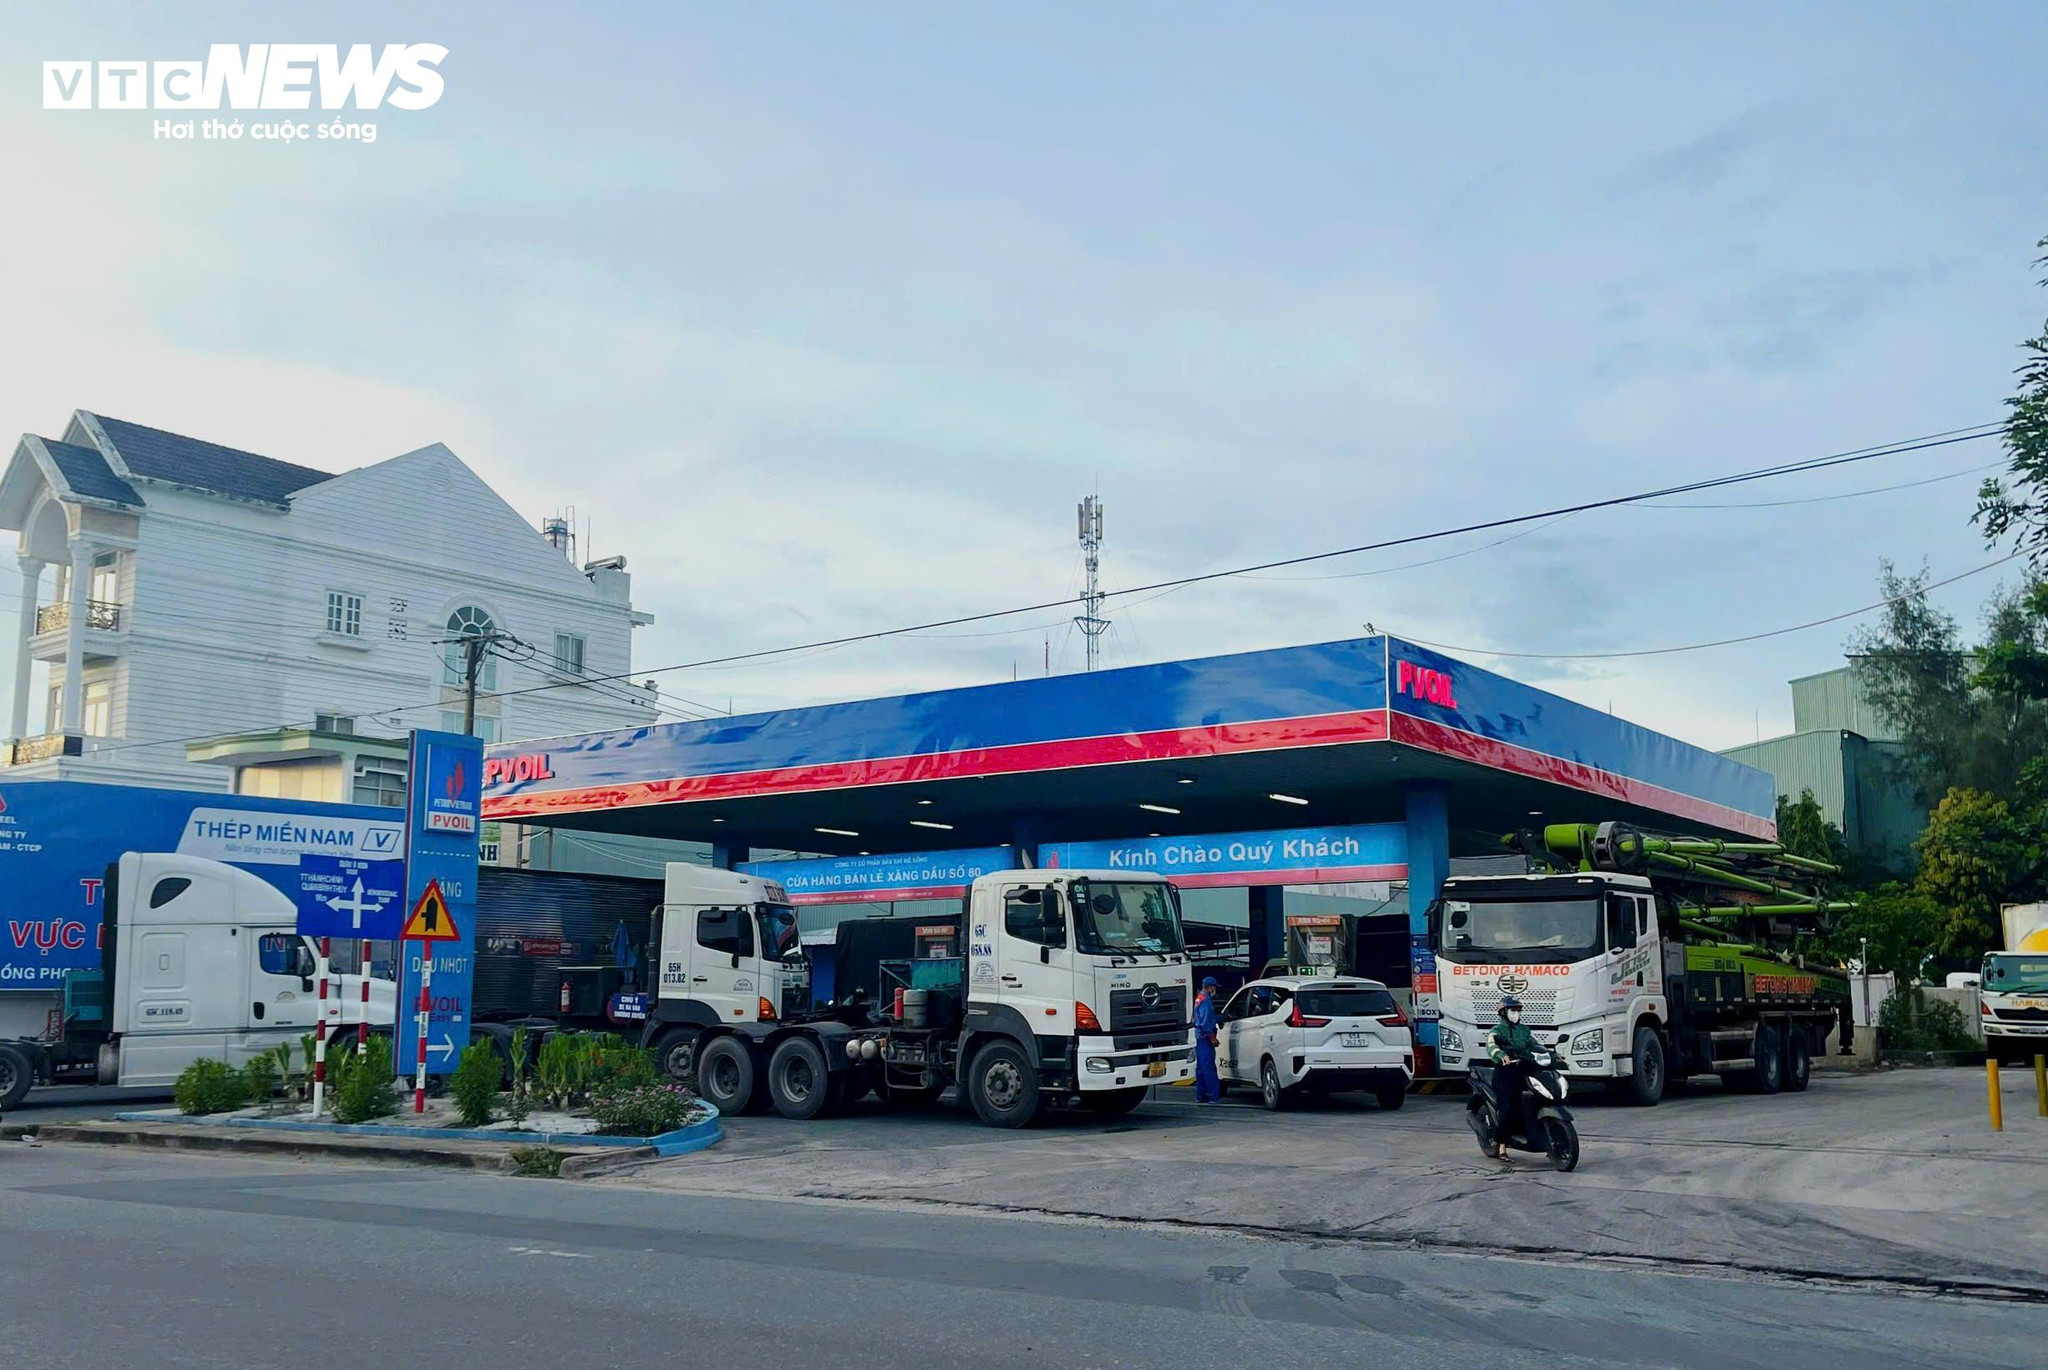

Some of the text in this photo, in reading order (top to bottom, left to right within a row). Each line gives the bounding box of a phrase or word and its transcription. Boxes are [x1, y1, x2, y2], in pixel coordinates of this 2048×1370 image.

[1397, 660, 1456, 708] PVOIL
[486, 754, 553, 785] PVOIL
[194, 819, 354, 846] THÉP MIỀN NAM
[433, 814, 471, 830] PVOIL
[17, 843, 42, 852] CTCP
[1109, 836, 1359, 867] Kính Chào Quý Khách
[811, 873, 841, 886] HÀNG
[887, 868, 919, 882] XĂNG
[949, 864, 965, 878] SỐ
[968, 867, 981, 878] 80
[9, 918, 86, 956] VỰC
[412, 956, 437, 973] DU
[668, 962, 682, 972] 65H
[1453, 965, 1570, 976] BETONG HAMACO
